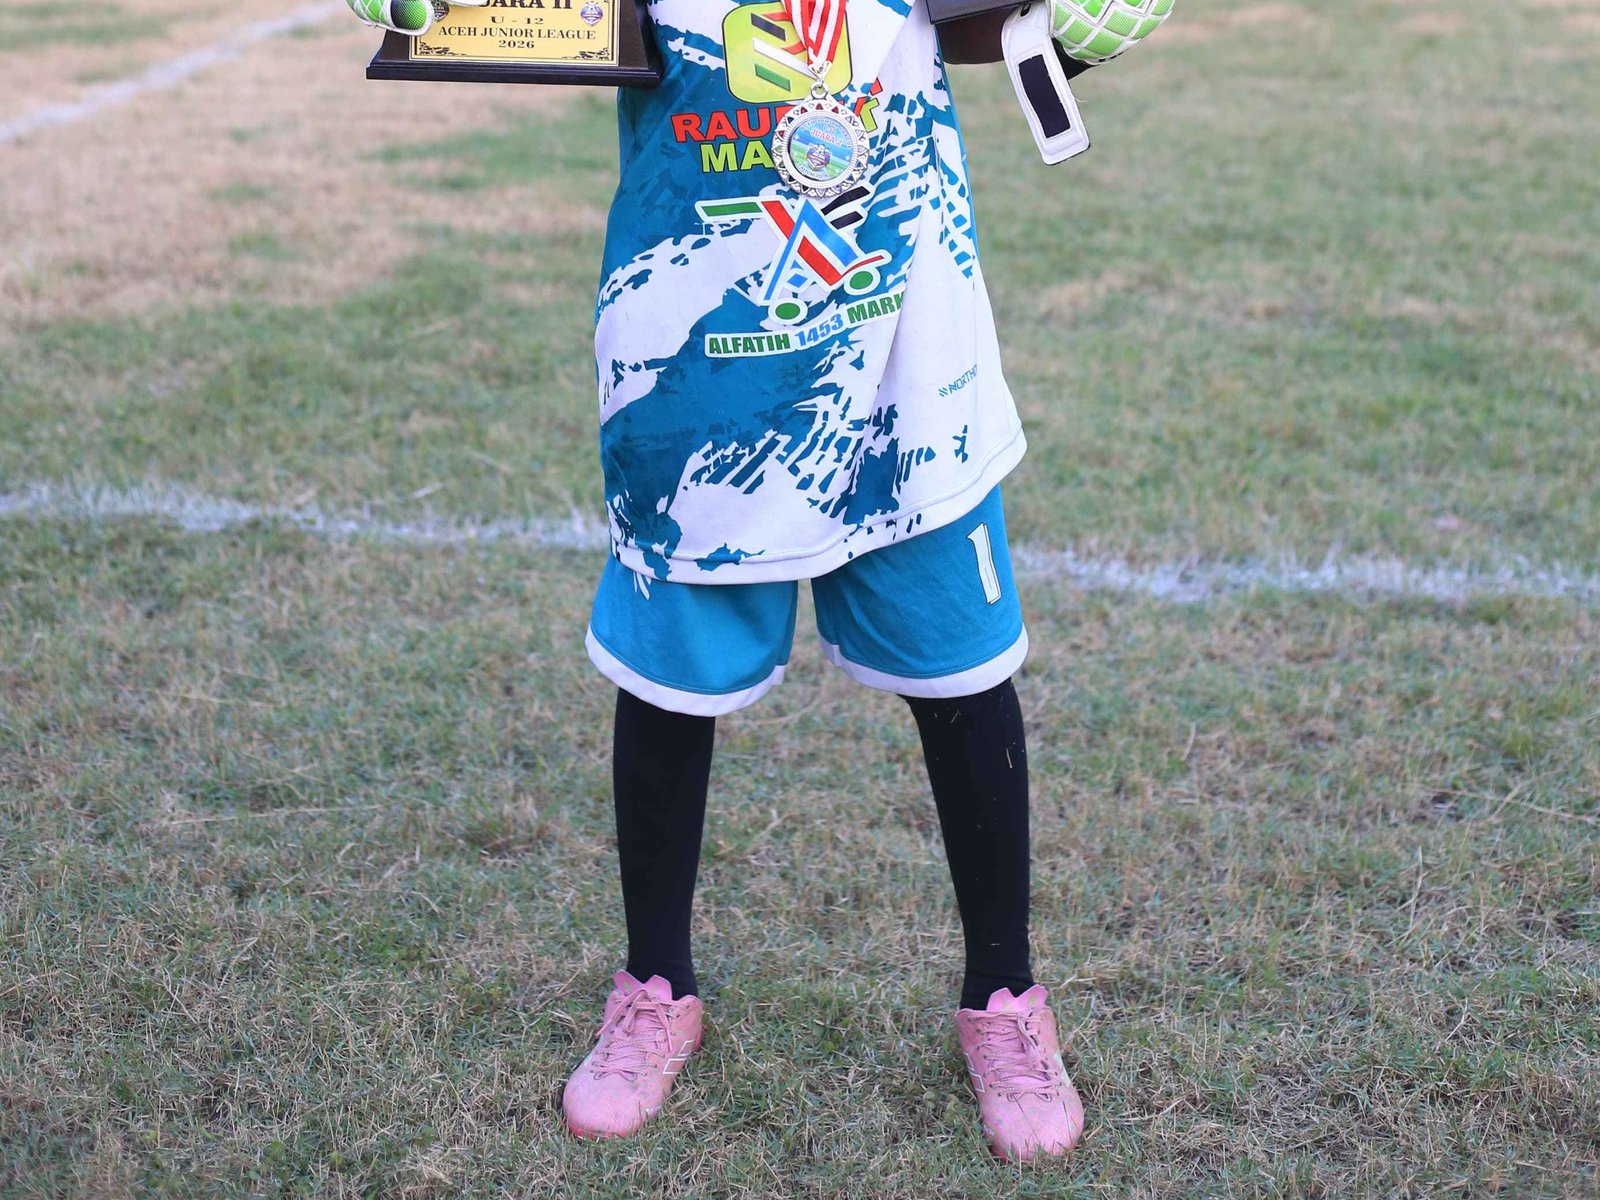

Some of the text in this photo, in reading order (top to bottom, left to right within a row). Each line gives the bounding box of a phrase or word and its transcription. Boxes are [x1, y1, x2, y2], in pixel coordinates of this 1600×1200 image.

[490, 16, 504, 24] U
[526, 17, 544, 25] 12
[438, 26, 596, 40] ACEH JUNIOR LEAGUE
[498, 40, 535, 49] 2026
[810, 128, 835, 143] JUARA
[708, 333, 791, 355] ALFATIH
[795, 313, 844, 346] 1453
[966, 521, 1002, 605] 1
